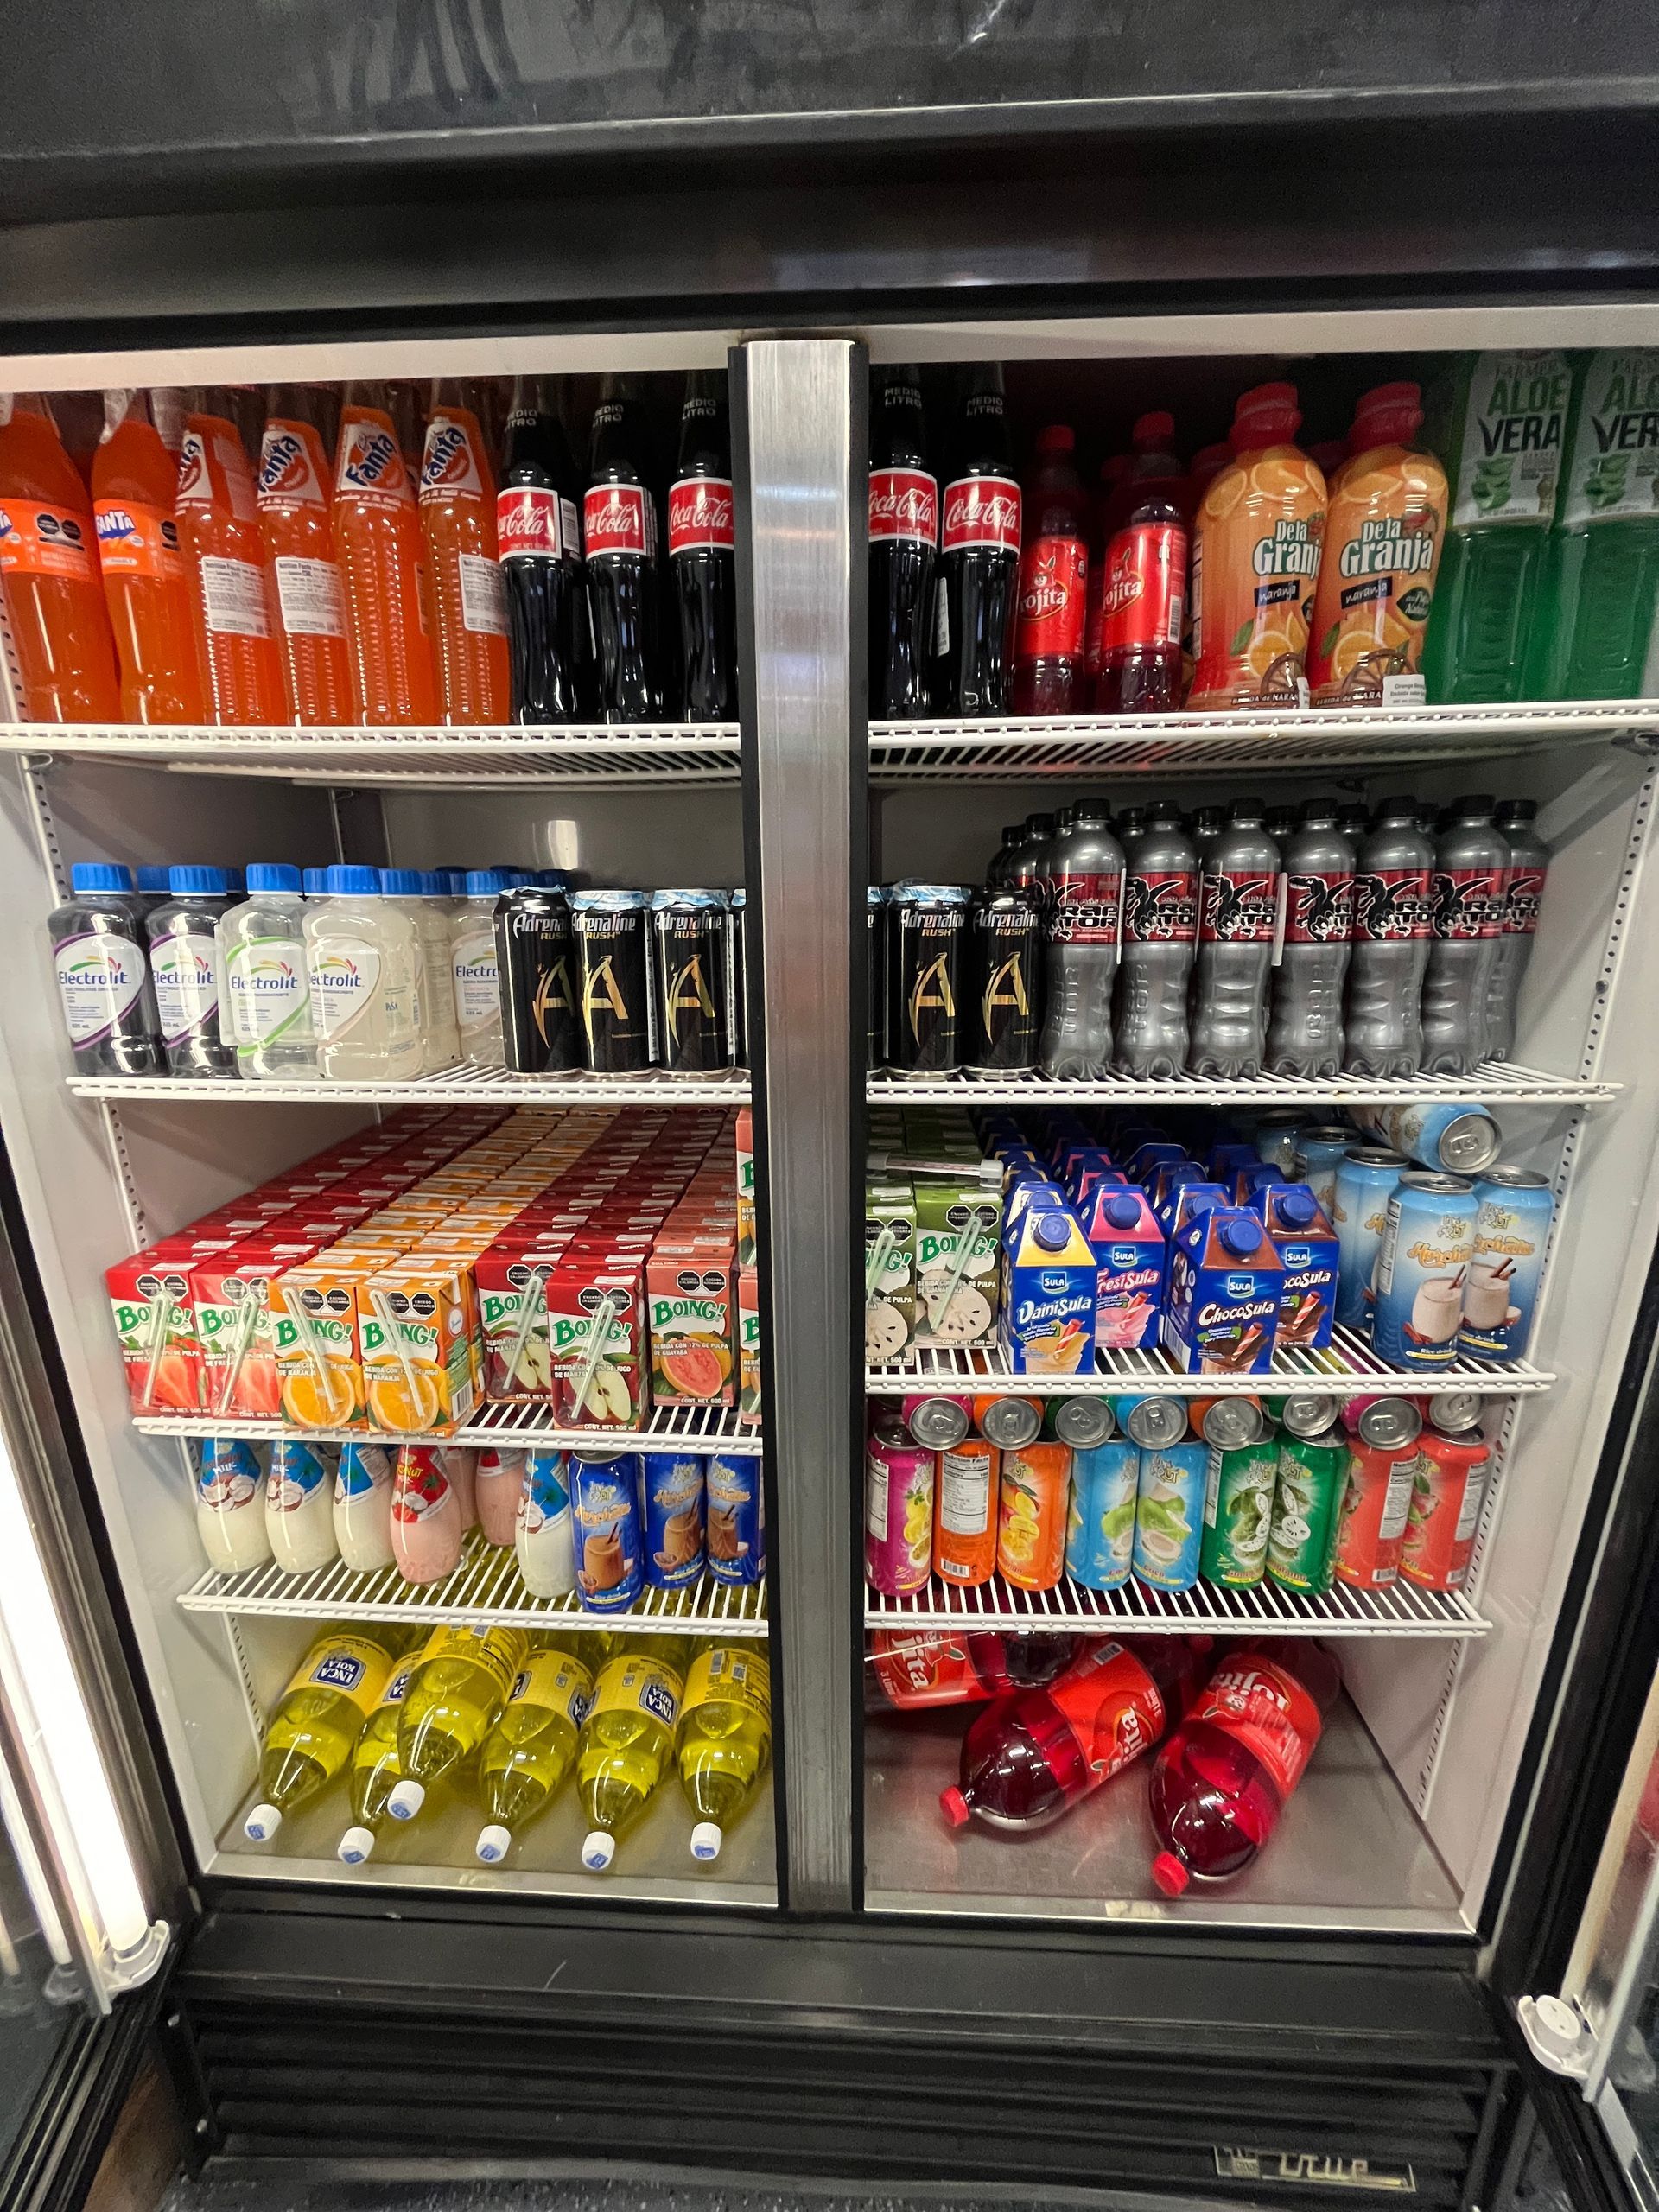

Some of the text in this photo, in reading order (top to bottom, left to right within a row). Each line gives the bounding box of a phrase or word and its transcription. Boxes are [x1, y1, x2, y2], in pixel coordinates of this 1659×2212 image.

[1487, 373, 1566, 416] ALOE
[1477, 414, 1562, 457] VERA
[1592, 411, 1659, 454] VER
[346, 435, 397, 486] Fanta
[945, 496, 1018, 539] Coca-Cola
[1340, 532, 1434, 578] Granja
[674, 931, 704, 939] RUSH
[922, 928, 951, 937] RUSH
[59, 971, 130, 985] Electrolit
[1114, 1252, 1135, 1261] SULA
[1287, 1253, 1307, 1262] SULA
[1044, 1278, 1065, 1287] SULA
[1230, 1281, 1251, 1291] SULA
[652, 1301, 727, 1329] BOING!
[1198, 1301, 1275, 1327] ChocoSula
[321, 1668, 355, 1684] INCA
[328, 1660, 356, 1673] KOLA
[648, 1694, 674, 1721] INCA
